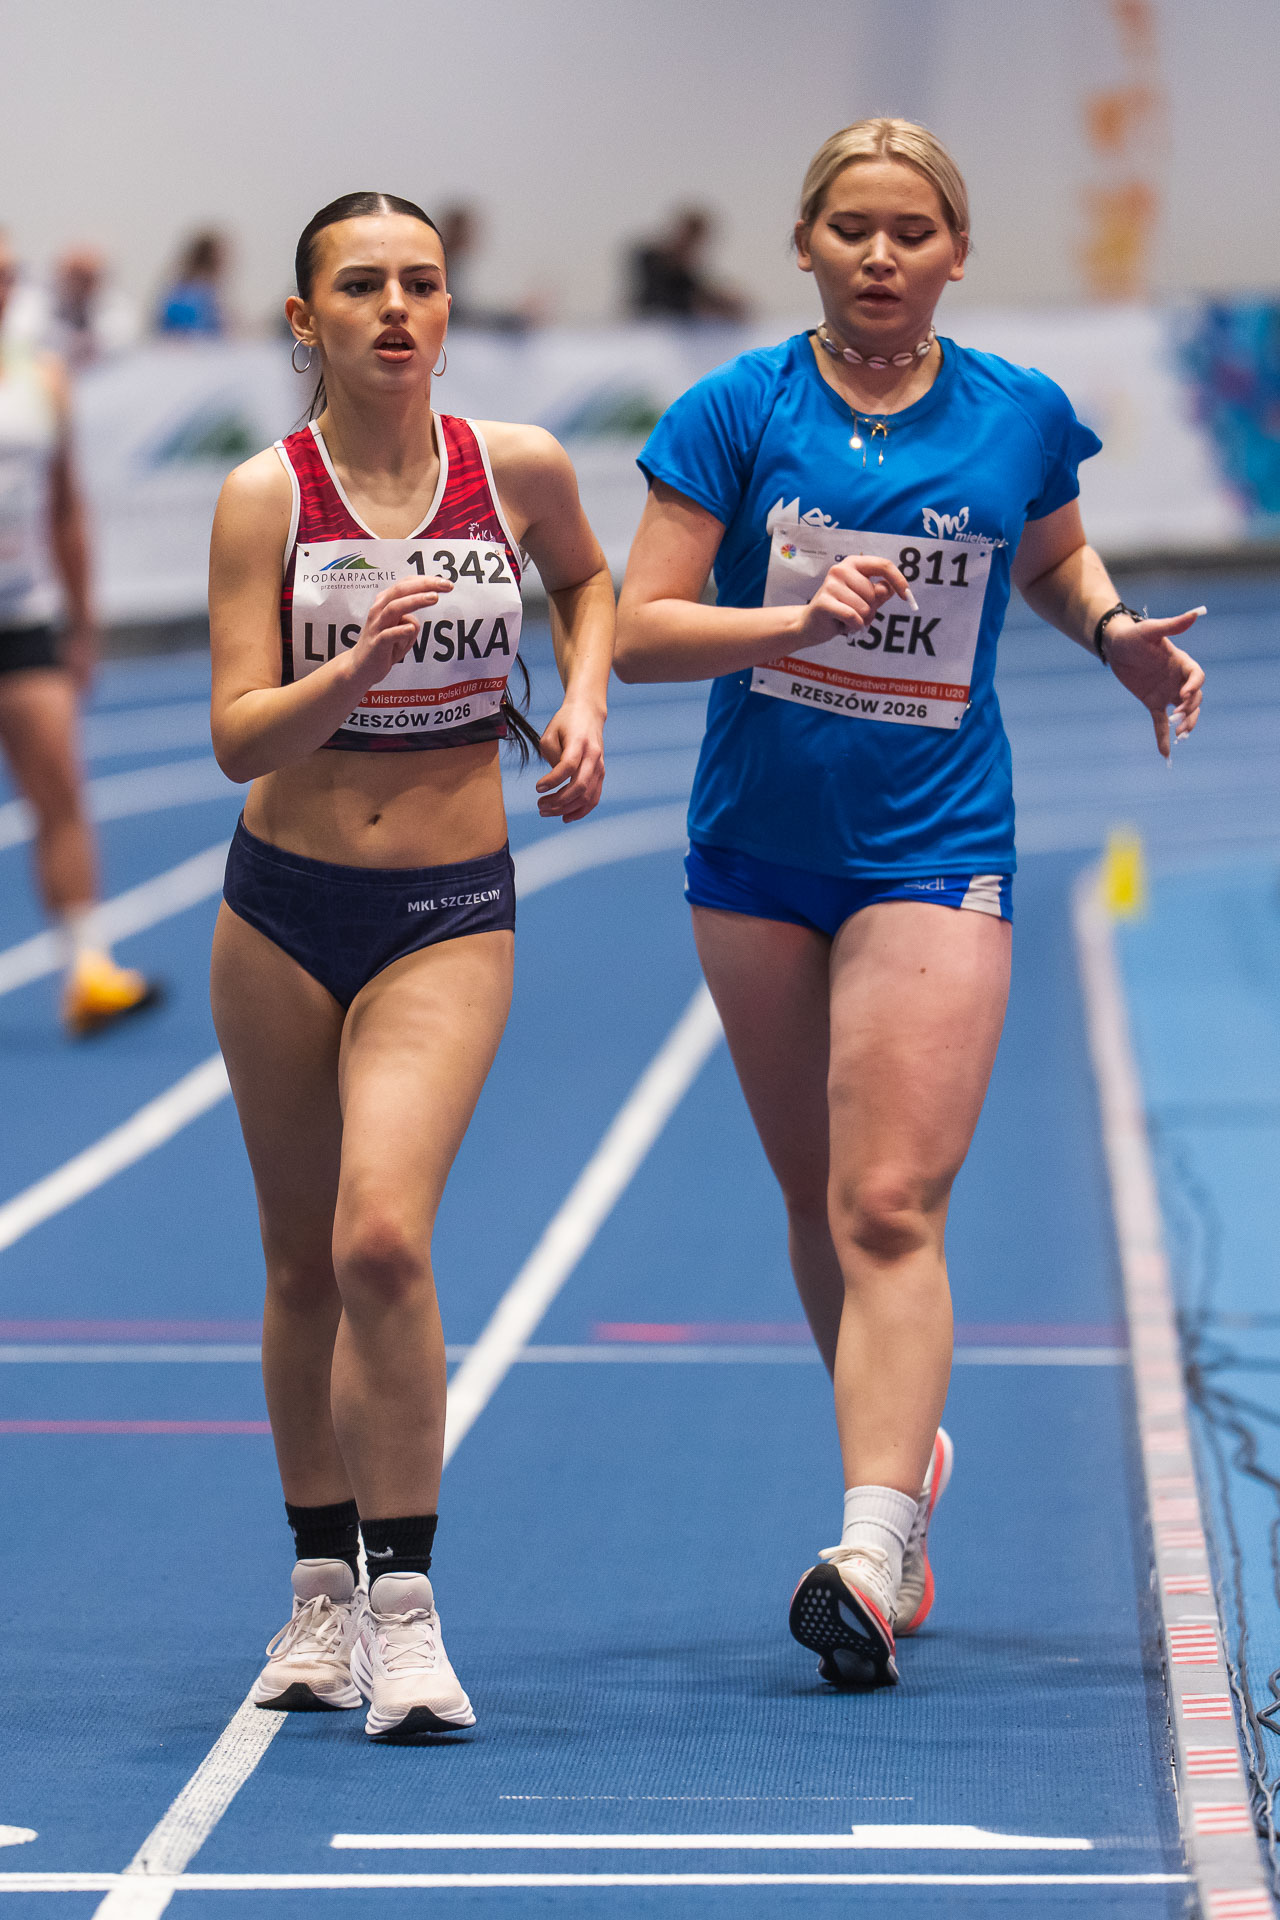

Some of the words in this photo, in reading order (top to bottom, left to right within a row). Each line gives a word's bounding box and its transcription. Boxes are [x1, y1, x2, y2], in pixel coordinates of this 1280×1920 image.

[303, 571, 397, 583] PODKARPACKIE
[406, 550, 512, 585] 1342
[898, 546, 969, 588] 811
[304, 617, 510, 664] LISSKA
[371, 694, 435, 704] Mistrzostwa
[438, 690, 461, 701] Polski
[462, 684, 477, 694] U18
[484, 680, 503, 690] U20
[787, 662, 825, 679] Halowe
[826, 672, 887, 691] Mistrzostwa
[889, 683, 918, 693] Polski
[920, 686, 937, 696] U18
[945, 690, 965, 699] U20
[343, 710, 430, 729] ZESZÓW
[433, 703, 471, 725] 2026
[790, 682, 879, 714] RZESZÓW
[882, 701, 927, 718] 2026
[407, 899, 438, 913] MKL
[440, 889, 500, 909] SZCZECIN
